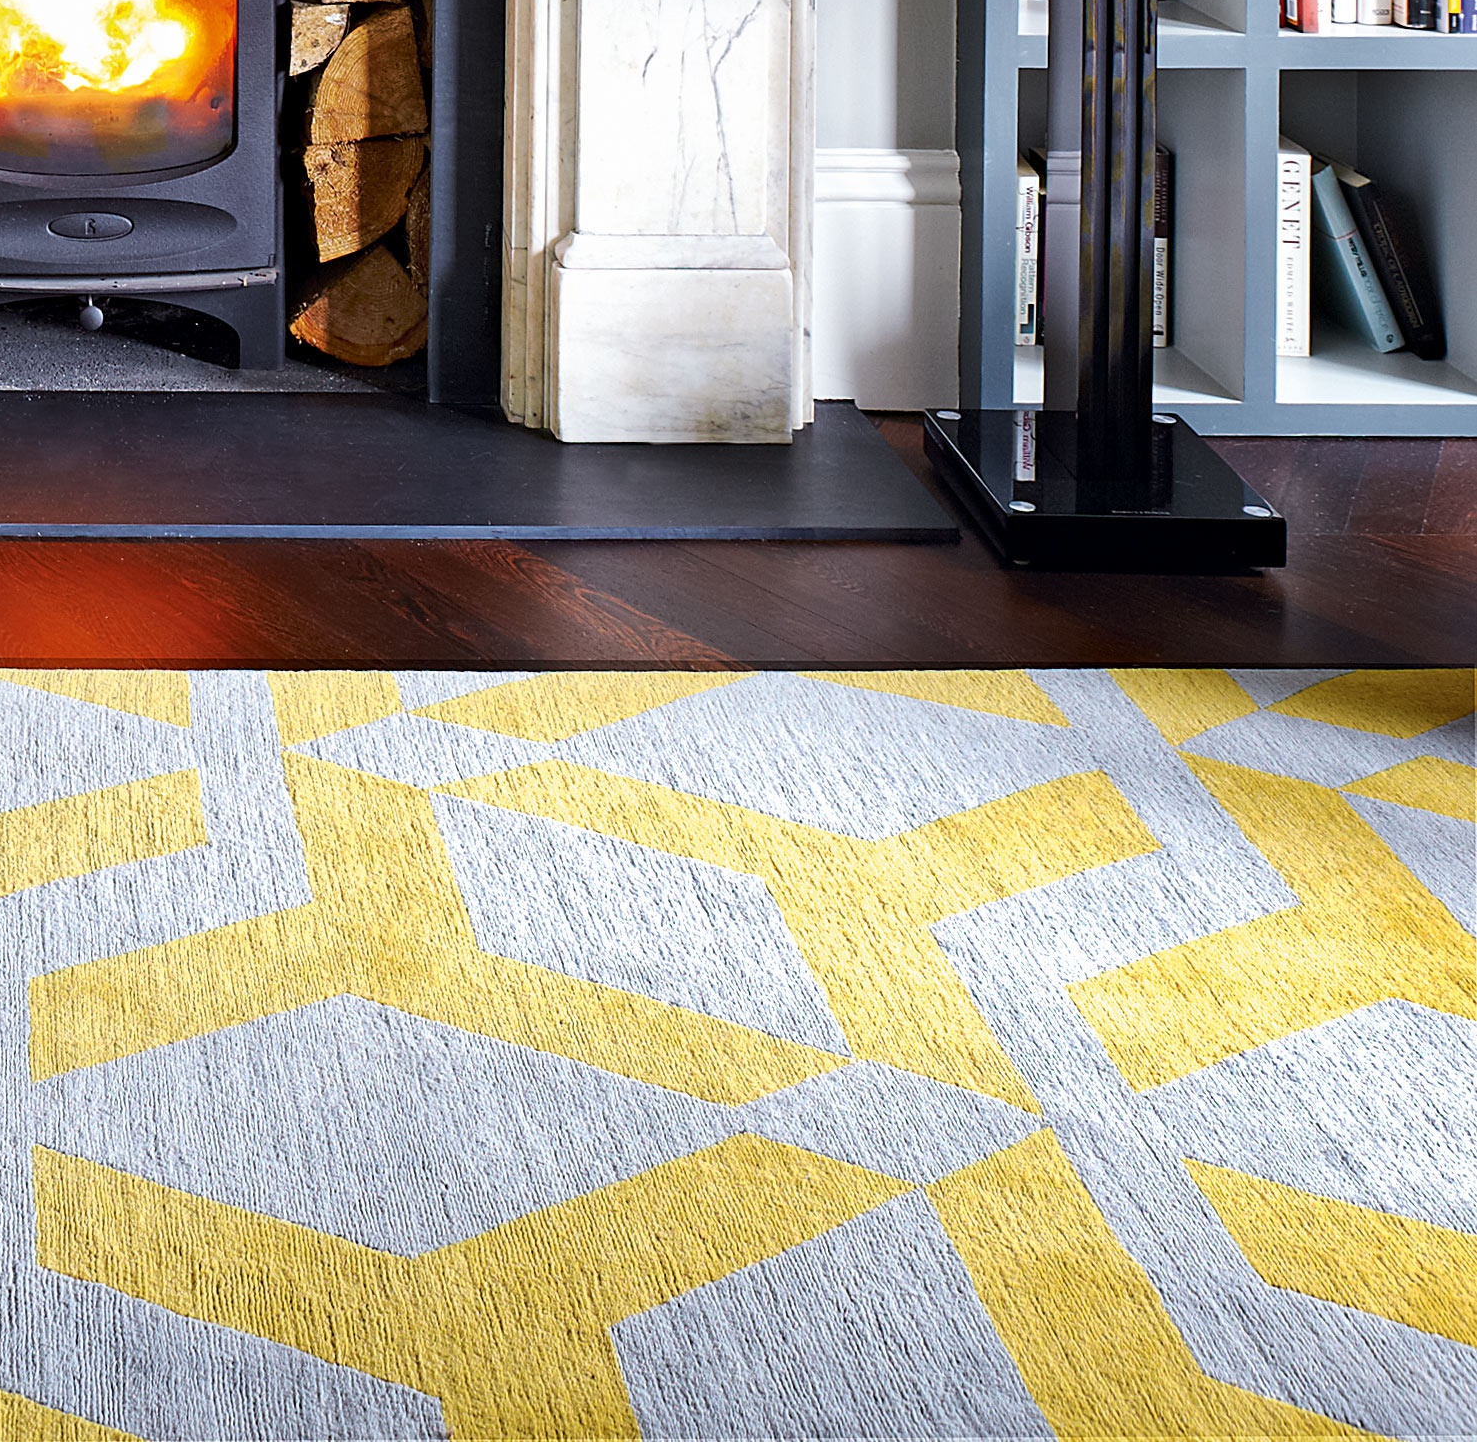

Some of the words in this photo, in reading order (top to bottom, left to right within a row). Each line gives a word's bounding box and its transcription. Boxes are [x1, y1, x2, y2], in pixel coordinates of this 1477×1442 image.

[1025, 186, 1034, 220] William
[1282, 160, 1301, 249] GENET
[1156, 247, 1165, 265] Door
[1156, 269, 1165, 291] Wide
[1154, 293, 1165, 316] Open
